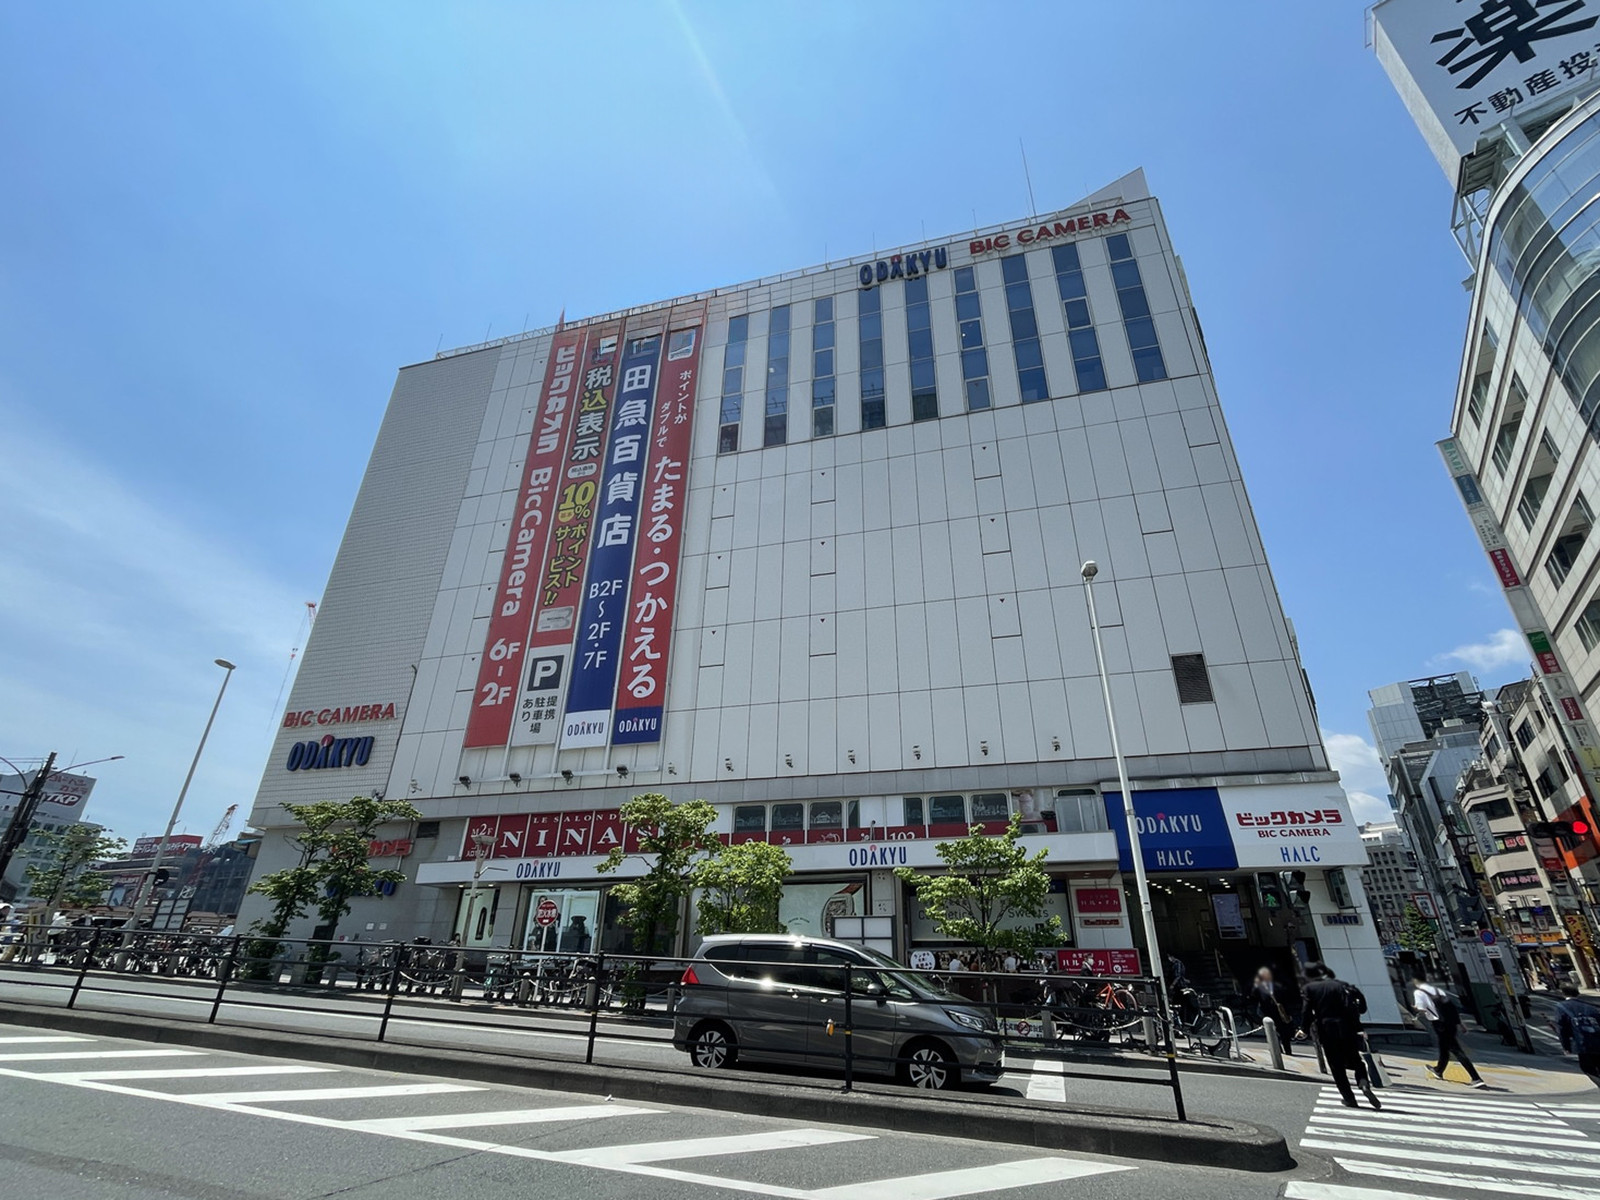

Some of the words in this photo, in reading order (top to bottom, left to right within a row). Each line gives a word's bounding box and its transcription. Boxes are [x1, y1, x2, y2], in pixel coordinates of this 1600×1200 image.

[1454, 43, 1600, 124] 不動産投
[970, 235, 1010, 256] BIC
[1017, 209, 1131, 244] CAMERA
[860, 247, 947, 285] ODAKYU
[536, 344, 576, 455] ビックカメラ
[674, 370, 692, 425] ポイントが
[571, 365, 613, 461] 税込表示
[656, 400, 672, 448] ダブルで
[501, 467, 553, 617] BicCamera
[564, 523, 587, 587] ポイント
[589, 580, 623, 599] B2F
[489, 638, 521, 661] 6F
[533, 660, 557, 687] P
[479, 682, 512, 707] 2F
[283, 710, 312, 728] BIC
[317, 702, 397, 726] CAMERA
[618, 716, 657, 734] ODAKYU
[567, 721, 604, 737] ODAKYU
[286, 734, 375, 772] ODAKYU
[1136, 812, 1202, 835] ODAKYU
[1236, 809, 1342, 827] ビックカメラ
[1257, 829, 1279, 838] BIC
[1279, 828, 1331, 838] CAMERA
[849, 845, 907, 866] ODAKYU
[1157, 850, 1194, 867] HALC
[1280, 846, 1321, 863] HALC
[517, 860, 560, 878] ODAKYU
